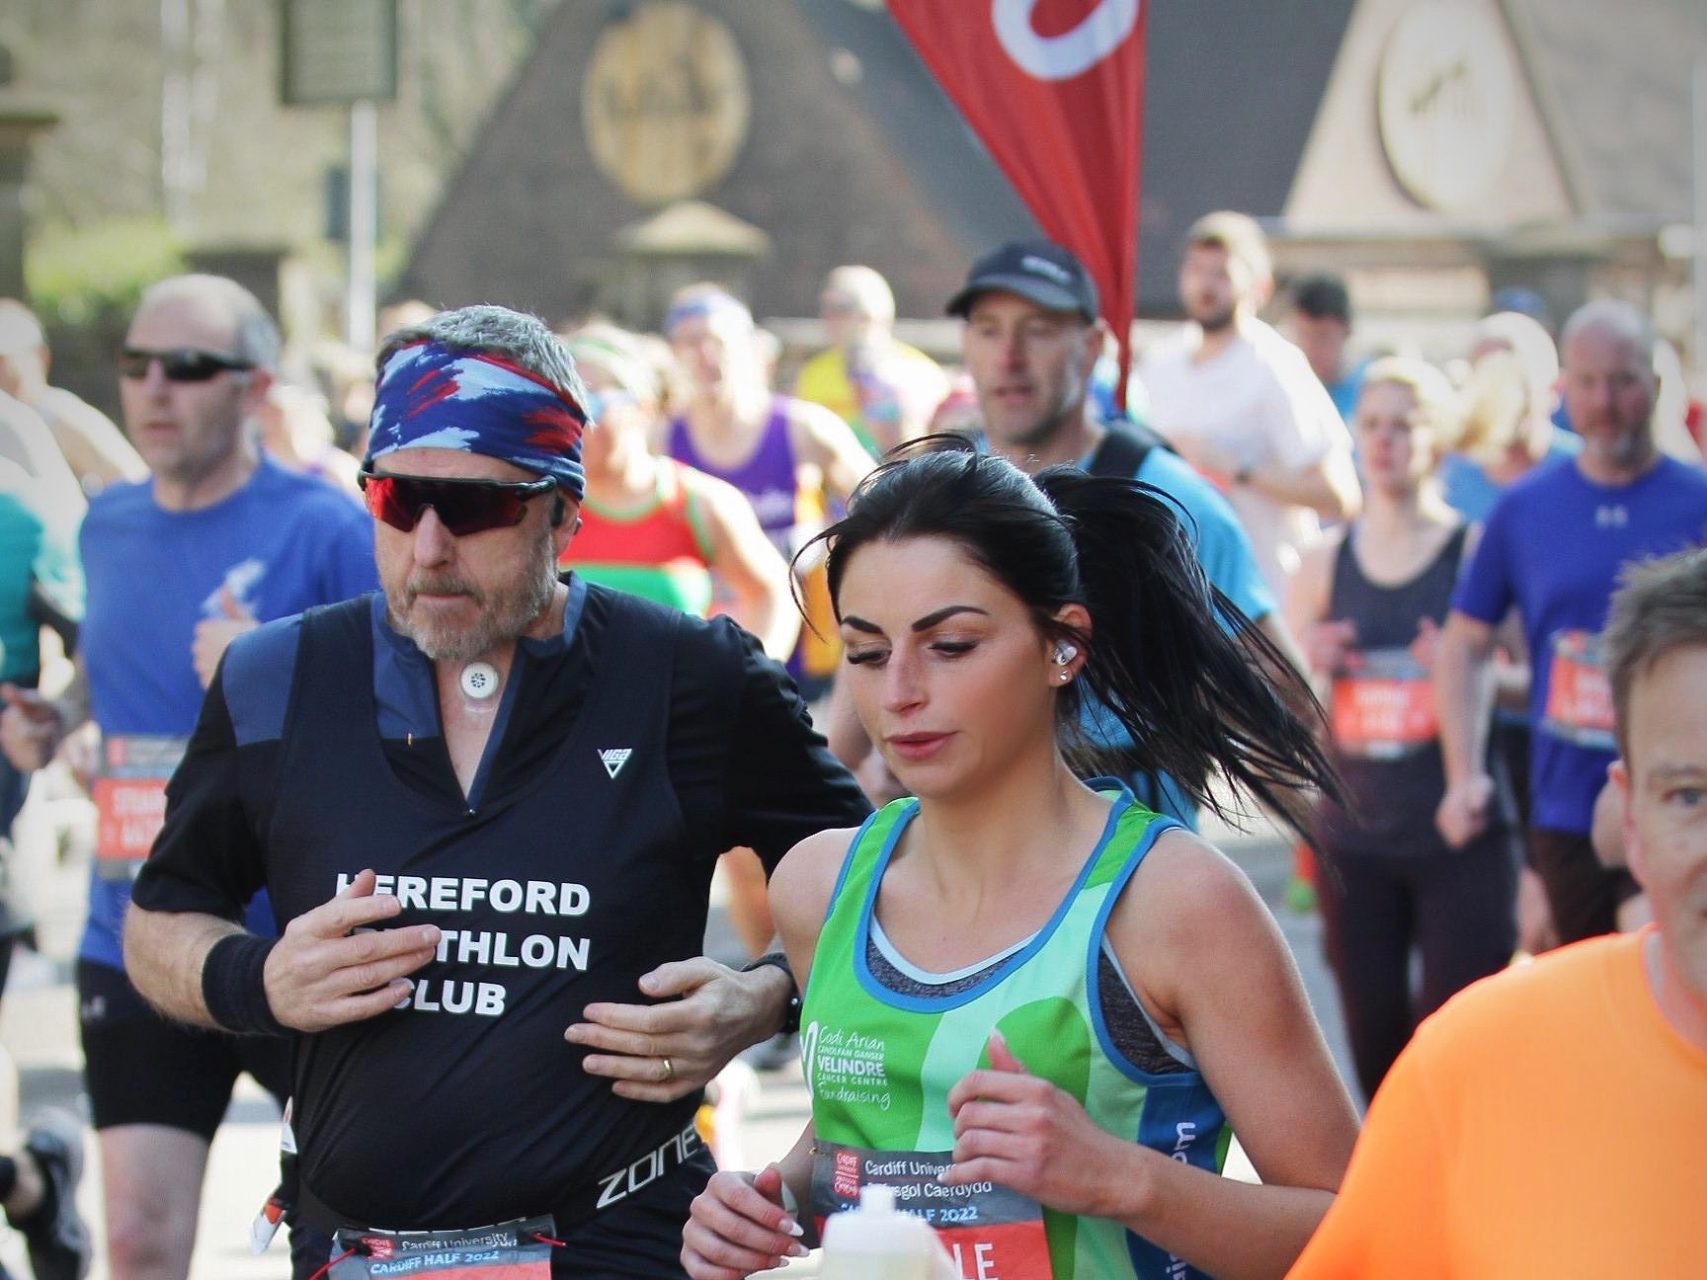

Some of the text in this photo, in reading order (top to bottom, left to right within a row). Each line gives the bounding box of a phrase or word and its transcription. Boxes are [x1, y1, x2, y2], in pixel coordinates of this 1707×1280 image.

[817, 1055, 885, 1078] VELINDRE
[818, 1081, 891, 1111] Fundraising
[865, 1160, 907, 1176] Cardiff
[941, 1206, 979, 1222] 2022
[370, 1249, 500, 1275] CARDIFF HALF 2022
